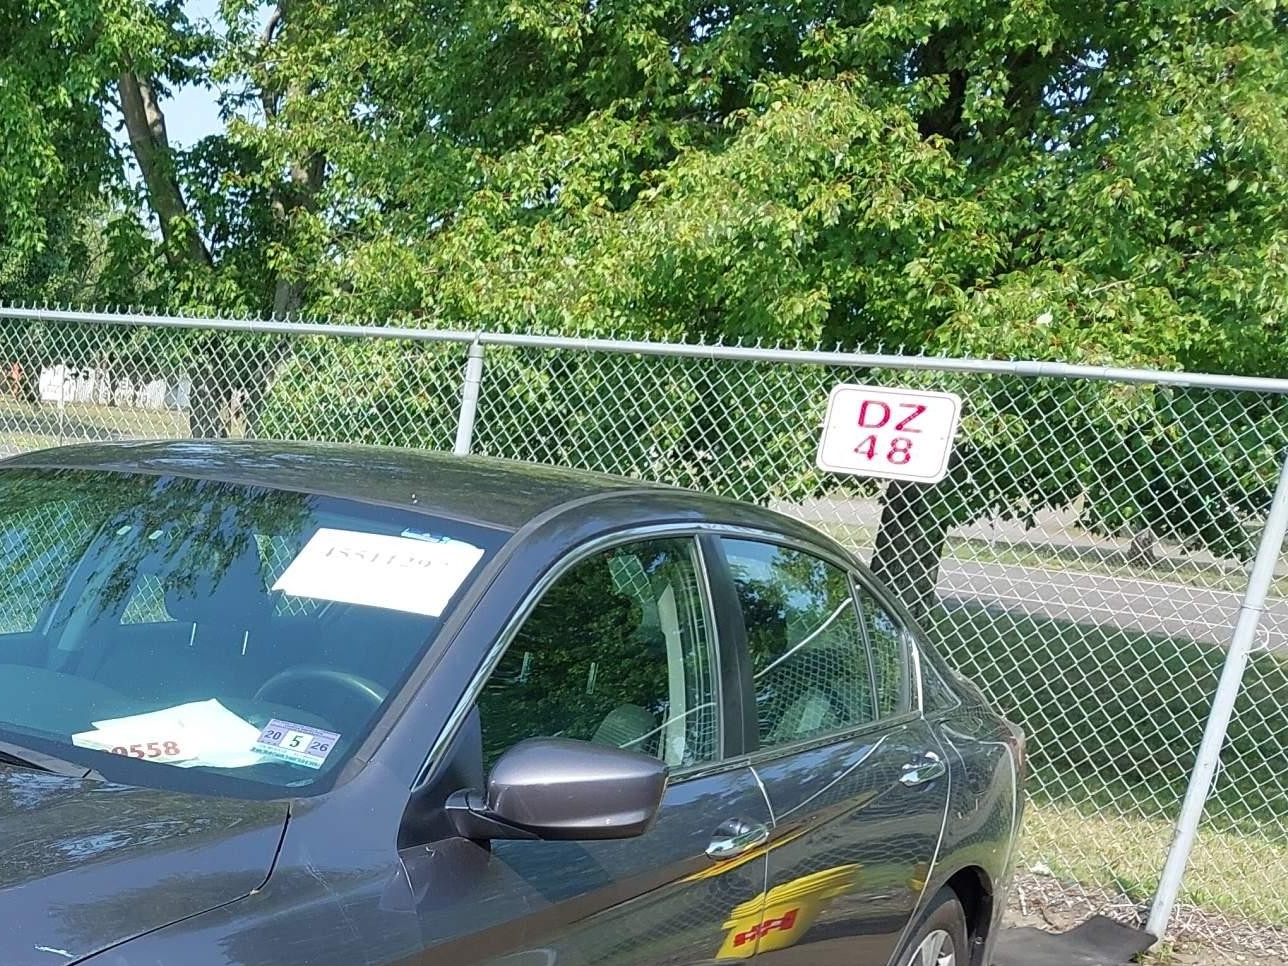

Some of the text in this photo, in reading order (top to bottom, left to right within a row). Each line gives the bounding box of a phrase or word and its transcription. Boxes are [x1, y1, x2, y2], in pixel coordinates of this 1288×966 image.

[857, 400, 927, 432] DZ
[853, 434, 913, 465] 48
[264, 730, 282, 741] 20
[289, 735, 304, 748] 5
[311, 741, 329, 752] 26
